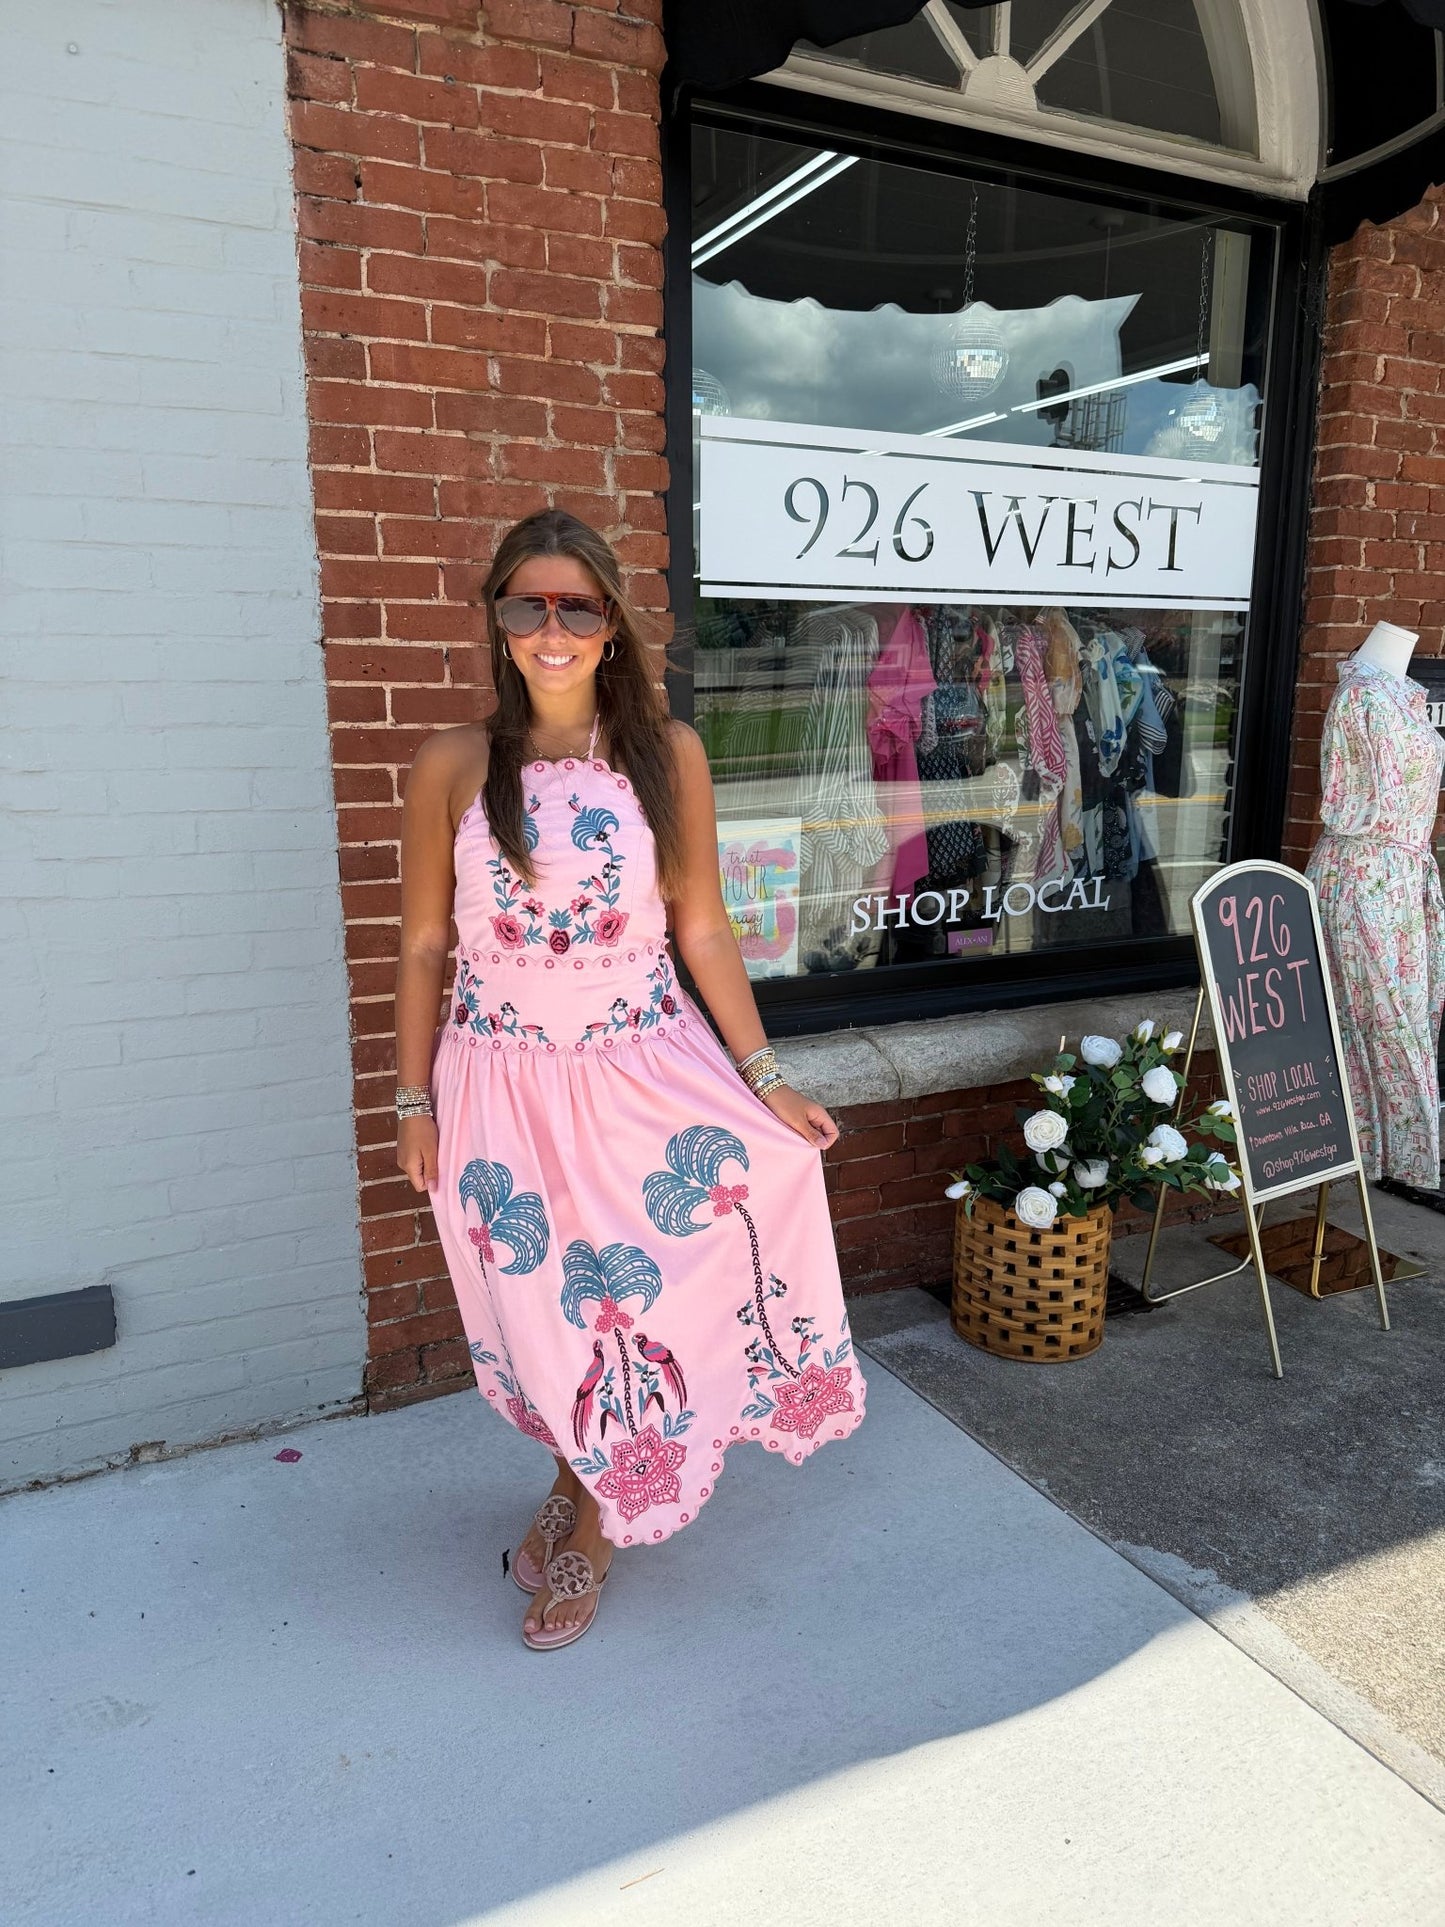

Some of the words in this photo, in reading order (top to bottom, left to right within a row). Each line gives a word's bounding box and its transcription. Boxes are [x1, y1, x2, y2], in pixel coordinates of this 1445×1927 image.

[783, 474, 935, 567] 926
[967, 489, 1203, 577] WEST
[727, 850, 762, 864] trust
[722, 864, 769, 902] YOUR
[849, 887, 970, 937] SHOP
[981, 875, 1110, 923] LOCAL
[1218, 894, 1291, 966] 926
[1215, 958, 1310, 1043] WEST
[1247, 1071, 1279, 1102] SHOP
[1283, 1062, 1320, 1093] LOCAL
[1253, 1131, 1283, 1148] Downtown
[1319, 1111, 1333, 1127] GA
[1262, 1143, 1338, 1179] @shop926westga
